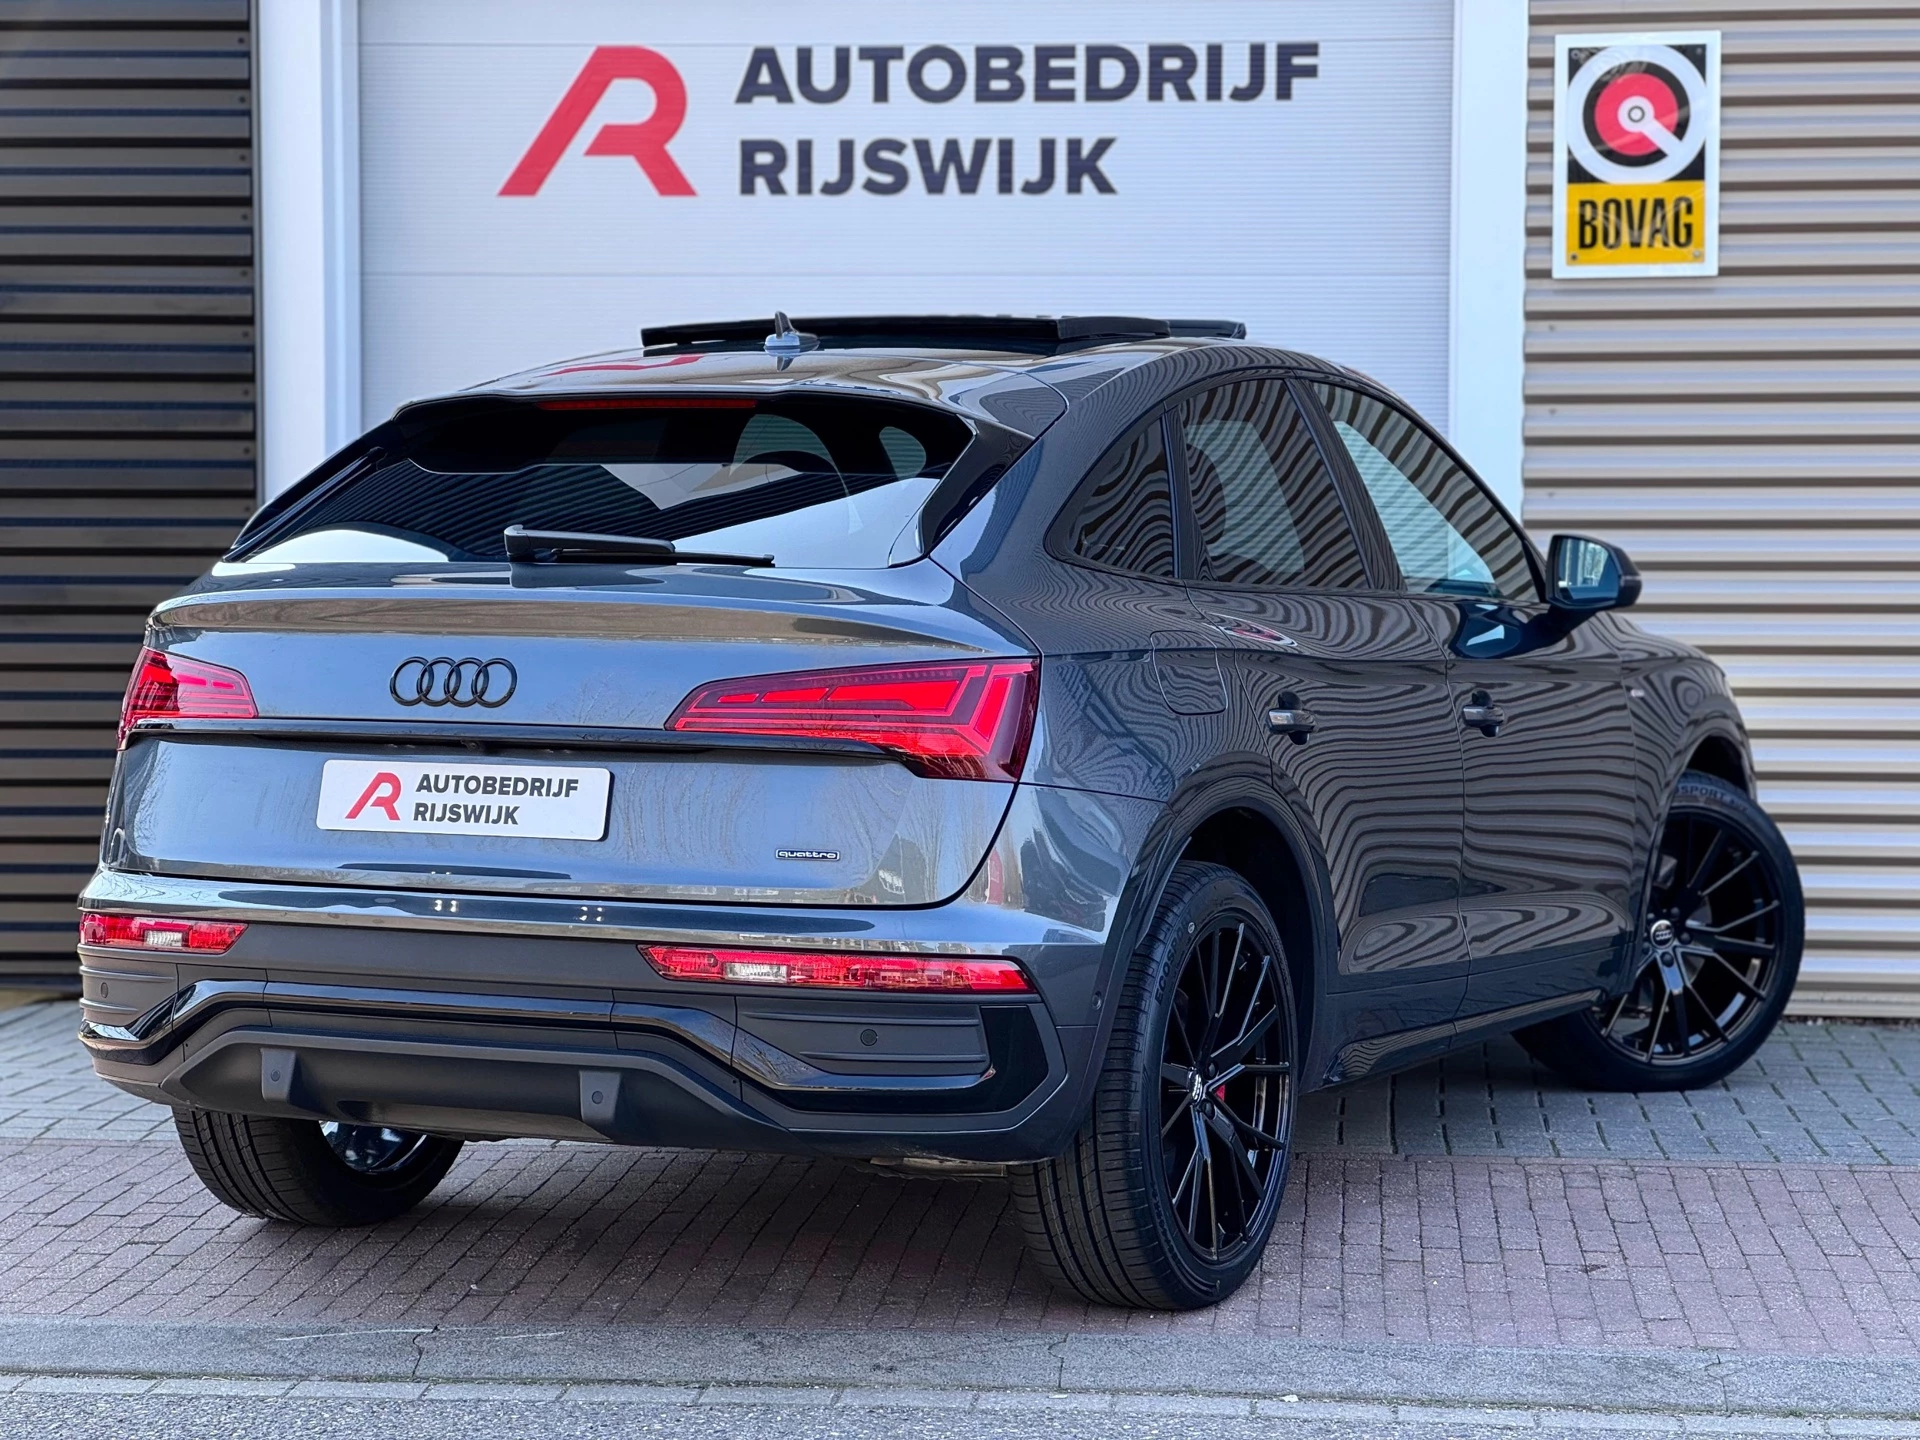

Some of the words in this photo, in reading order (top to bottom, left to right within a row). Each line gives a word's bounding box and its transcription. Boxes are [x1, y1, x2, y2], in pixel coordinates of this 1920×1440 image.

[735, 42, 1319, 104] AUTOBEDRIJF
[740, 137, 1117, 196] RIJSWIJK
[1578, 196, 1693, 250] BOVAG
[415, 773, 579, 798] AUTOBEDRIJF
[413, 802, 520, 825] RIJSWIJK
[778, 850, 837, 859] quattro
